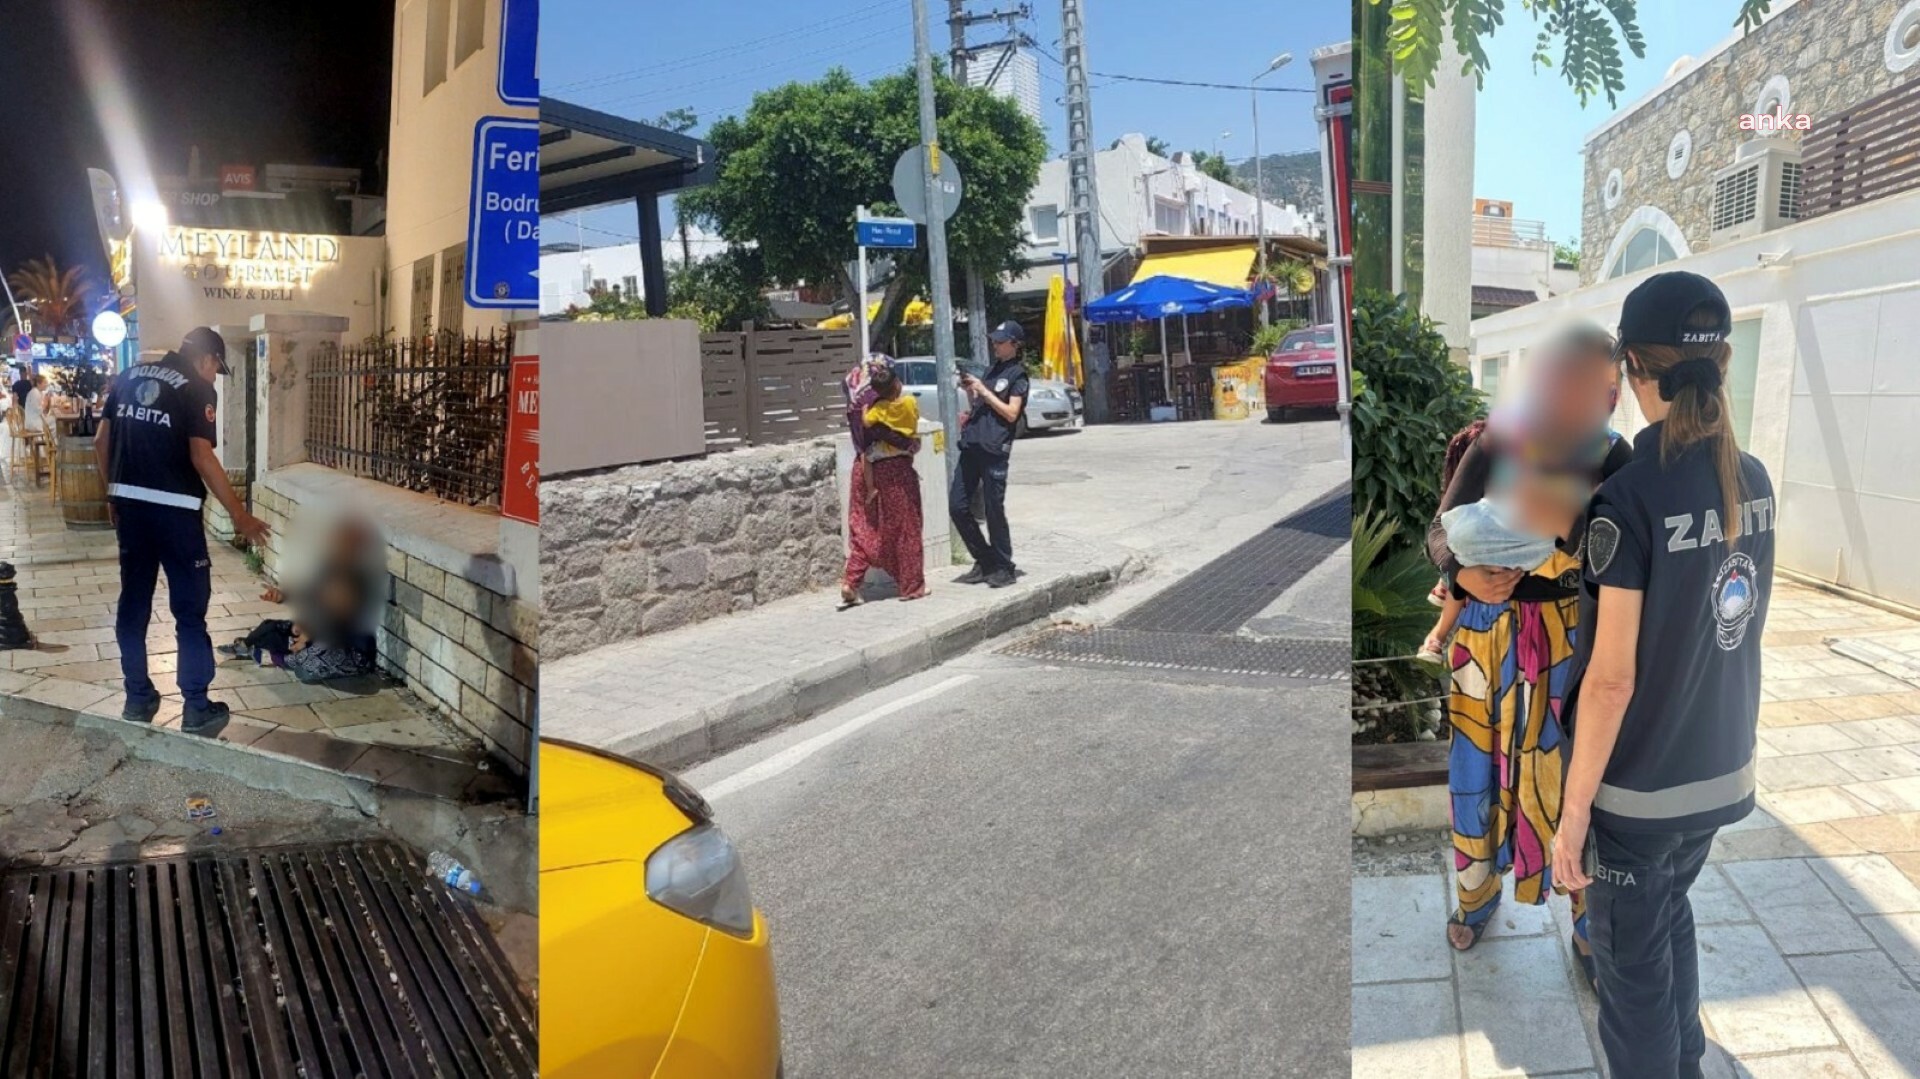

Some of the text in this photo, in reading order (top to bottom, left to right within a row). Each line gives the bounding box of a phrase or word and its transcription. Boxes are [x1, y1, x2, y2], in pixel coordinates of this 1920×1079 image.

[224, 174, 251, 184] AVIS
[181, 192, 220, 206] SHOP
[160, 231, 340, 263] MEYLAND
[184, 263, 314, 285] GOURMET
[204, 287, 294, 301] WINE & DELI
[1682, 332, 1720, 343] ZABITA
[116, 404, 171, 428] ZABITA
